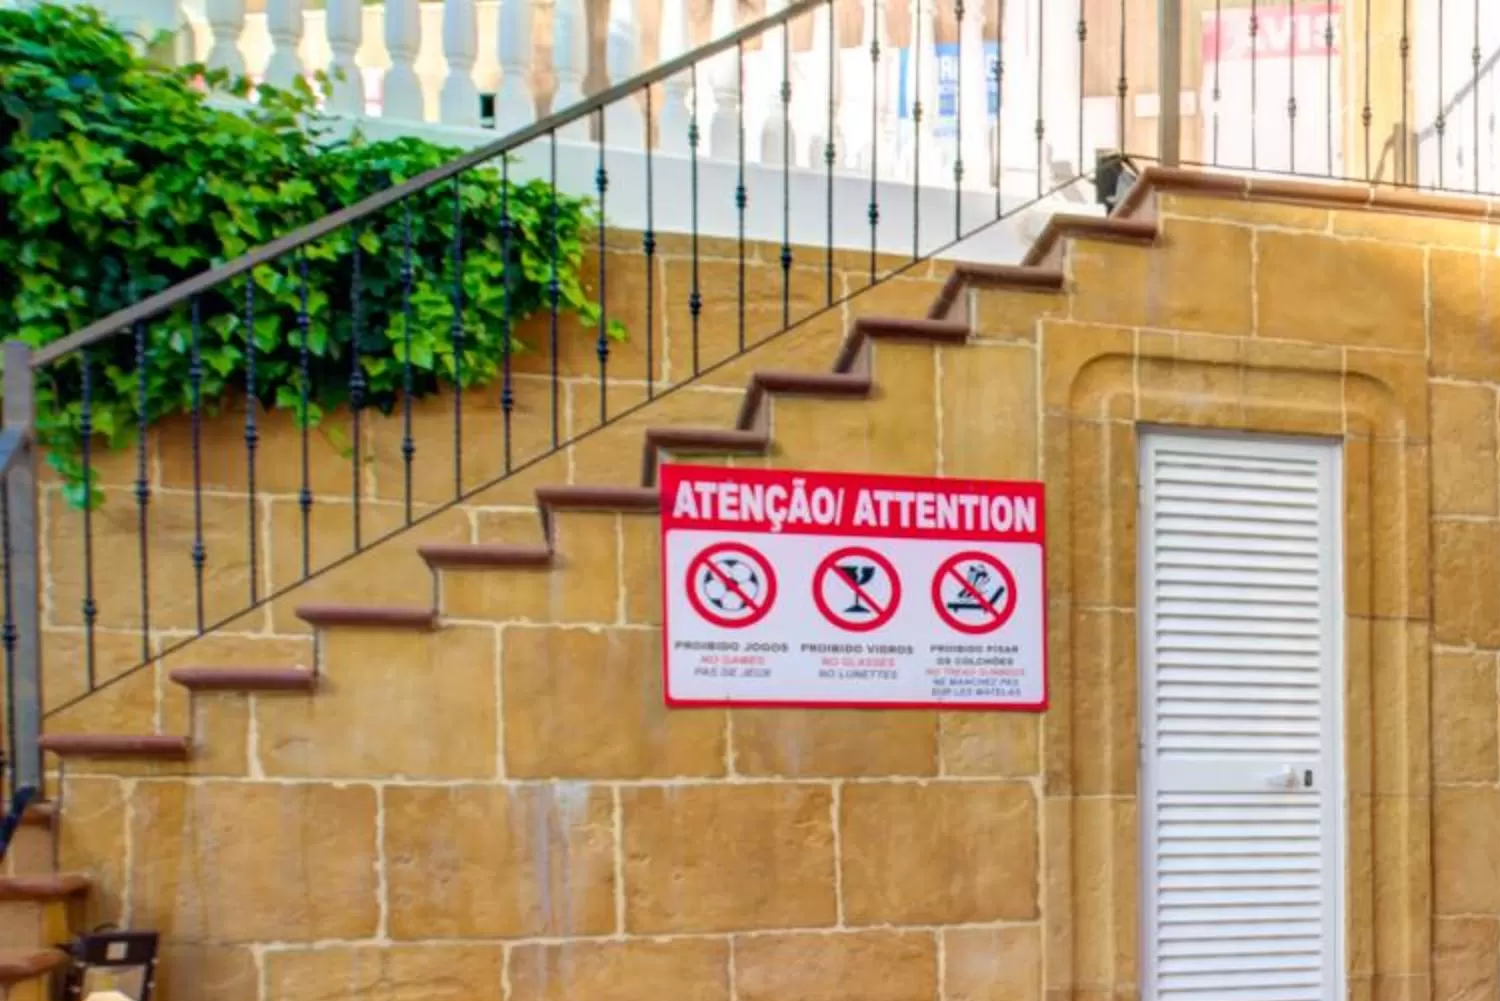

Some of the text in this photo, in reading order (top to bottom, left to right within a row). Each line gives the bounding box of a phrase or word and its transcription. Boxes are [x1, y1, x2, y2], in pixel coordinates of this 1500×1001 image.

[853, 487, 1036, 532] ATTENTION
[674, 641, 789, 653] PROIBIDO JOGOS
[800, 643, 863, 653] PROIBIDO
